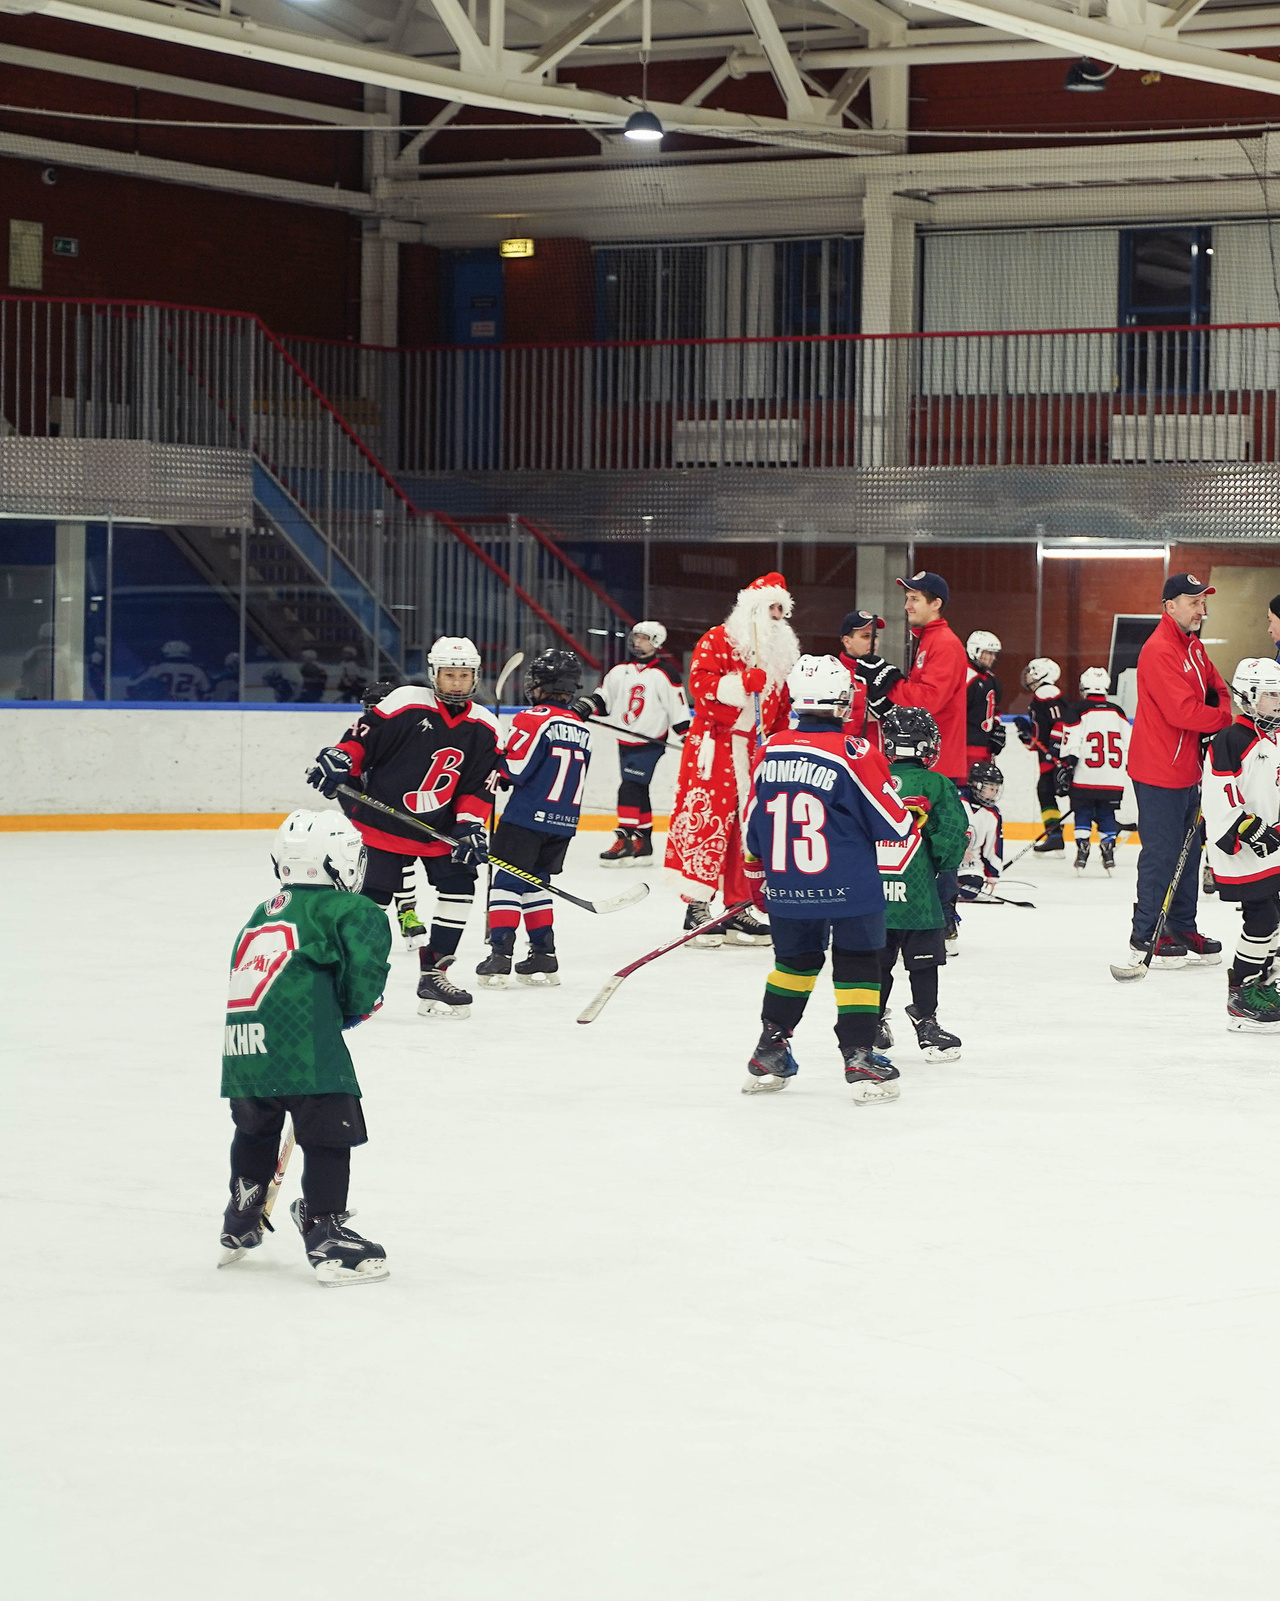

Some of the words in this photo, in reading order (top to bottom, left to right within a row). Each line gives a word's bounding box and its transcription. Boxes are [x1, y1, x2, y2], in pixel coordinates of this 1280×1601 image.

[545, 745, 587, 805] 77
[1085, 730, 1122, 769] 35
[765, 790, 830, 875] 13
